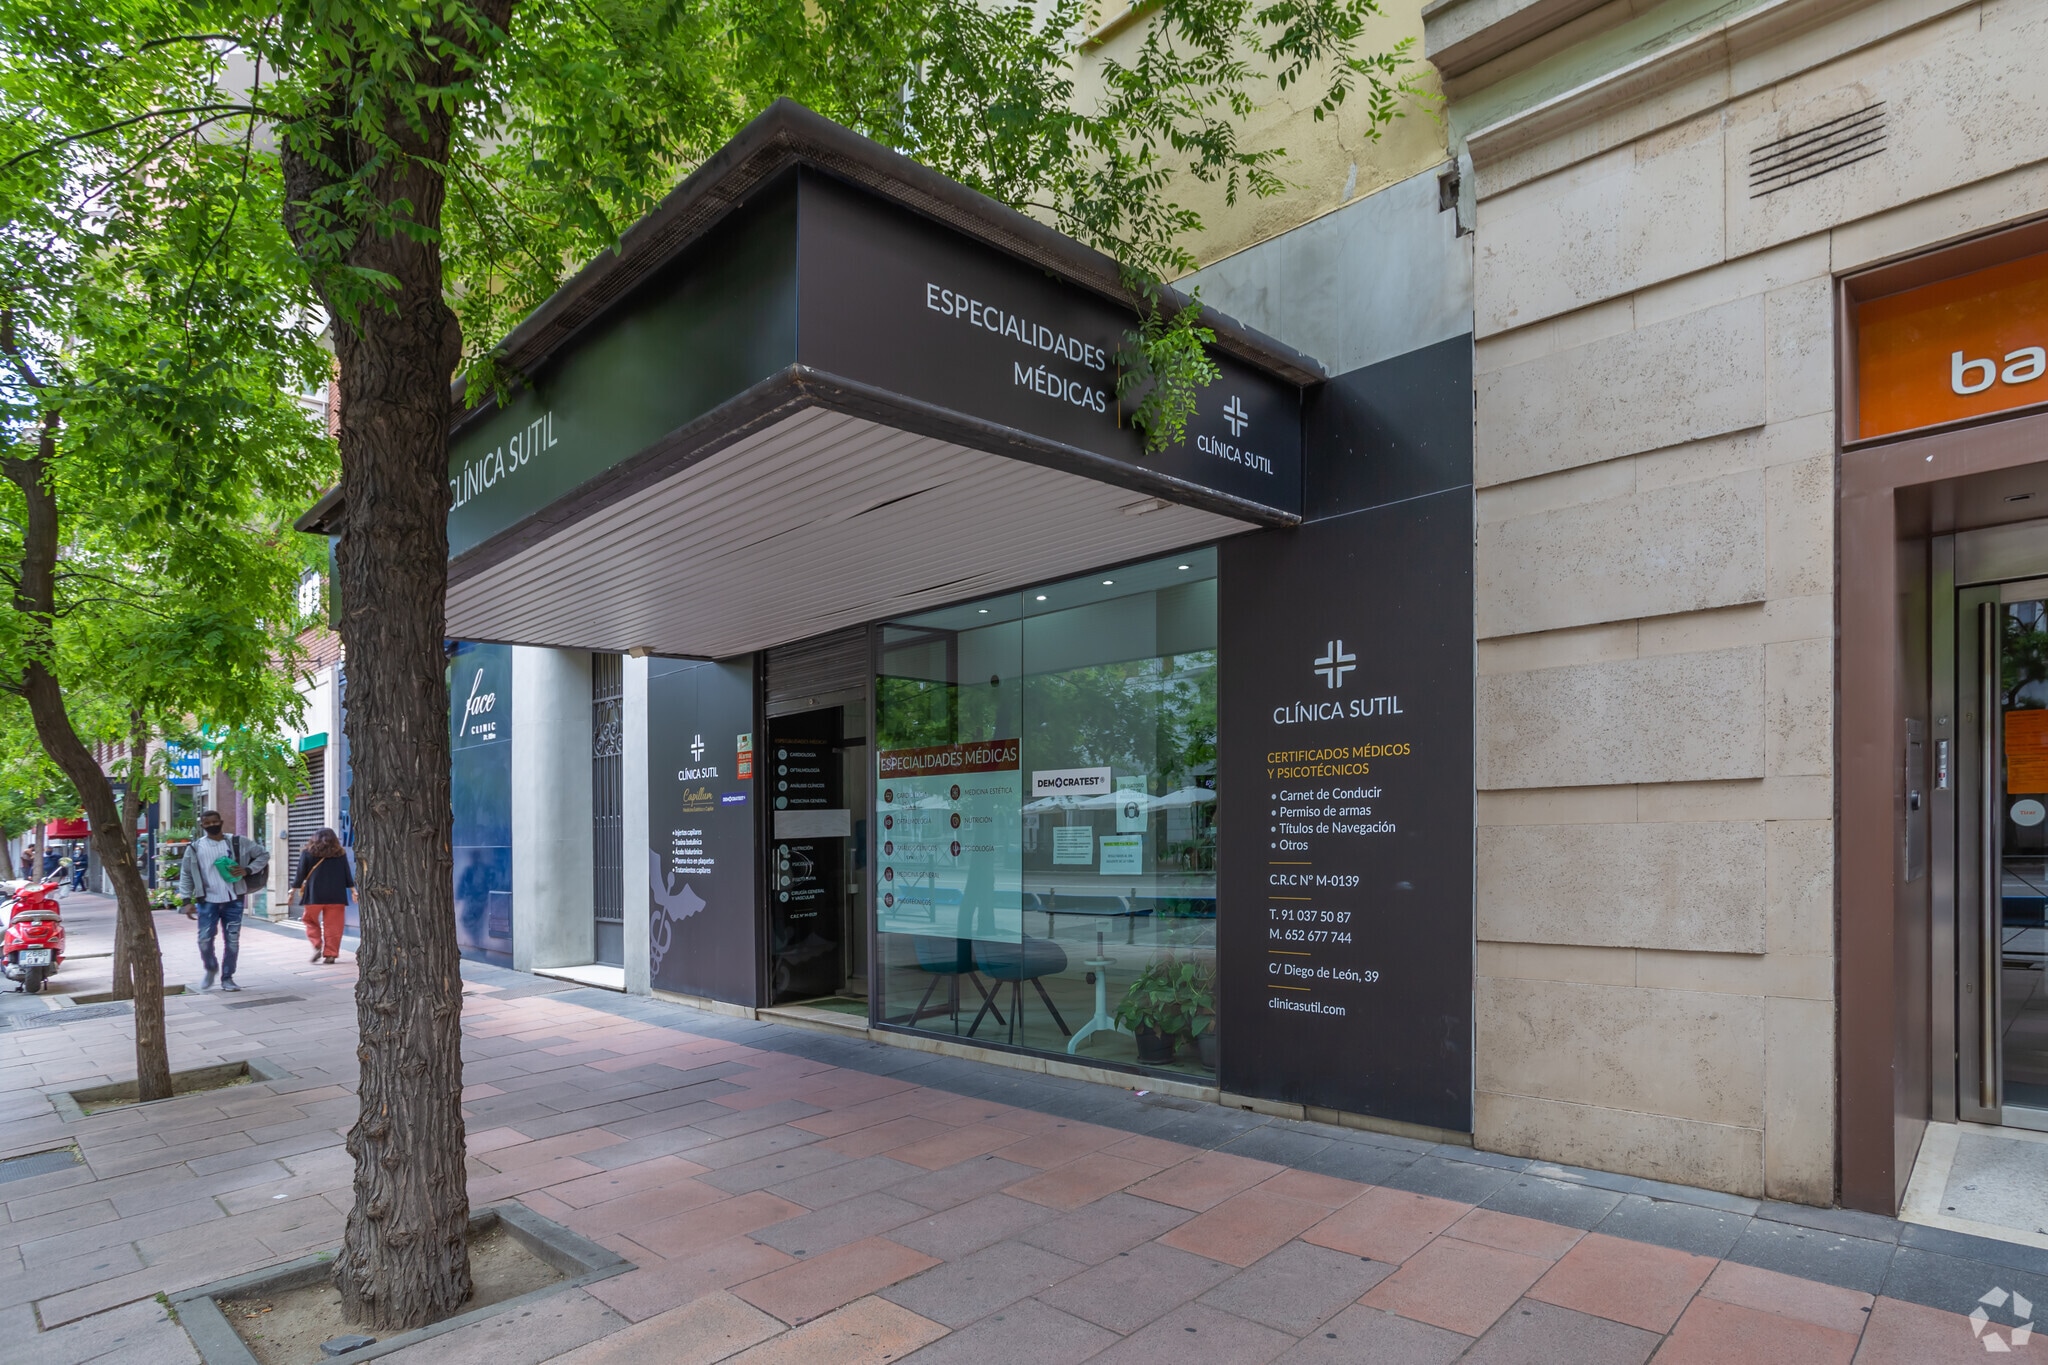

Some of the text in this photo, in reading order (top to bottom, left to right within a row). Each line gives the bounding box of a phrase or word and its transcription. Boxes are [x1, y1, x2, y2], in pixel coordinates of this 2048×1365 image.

[926, 282, 1105, 372] ESPECIALIDADES
[1951, 346, 2046, 395] ba
[1013, 360, 1106, 414] MÉDICAS
[508, 411, 558, 473] SUTIL
[1197, 434, 1274, 476] CLÍNICA SUTIL
[460, 668, 496, 737] face
[1273, 695, 1403, 725] CLÍNICA SUTIL
[471, 722, 496, 735] CLINIC
[880, 747, 1017, 771] ESPECIALIDADES MÉDICAS
[1267, 743, 1411, 764] CERTIFICADOS MÉDICOS
[678, 766, 719, 781] CLÍNICA SUTIL
[1267, 763, 1369, 779] Y PSICOTÉCNICOS
[964, 788, 989, 796] MEDICINA
[1279, 786, 1382, 801] Carnet de Conducir
[1279, 805, 1371, 818] Permiso de armas
[964, 816, 993, 824] NUTRICIÓN
[1279, 821, 1396, 836] Títulos de Navegación
[1279, 839, 1309, 851] Otros
[1316, 875, 1360, 887] M-0139
[1269, 908, 1351, 924] T. 91 037 50 87
[1269, 928, 1352, 944] M. 652 677 744
[1268, 963, 1380, 983] C/ Diego de León, 39
[1268, 997, 1346, 1016] clinicasutil.com
